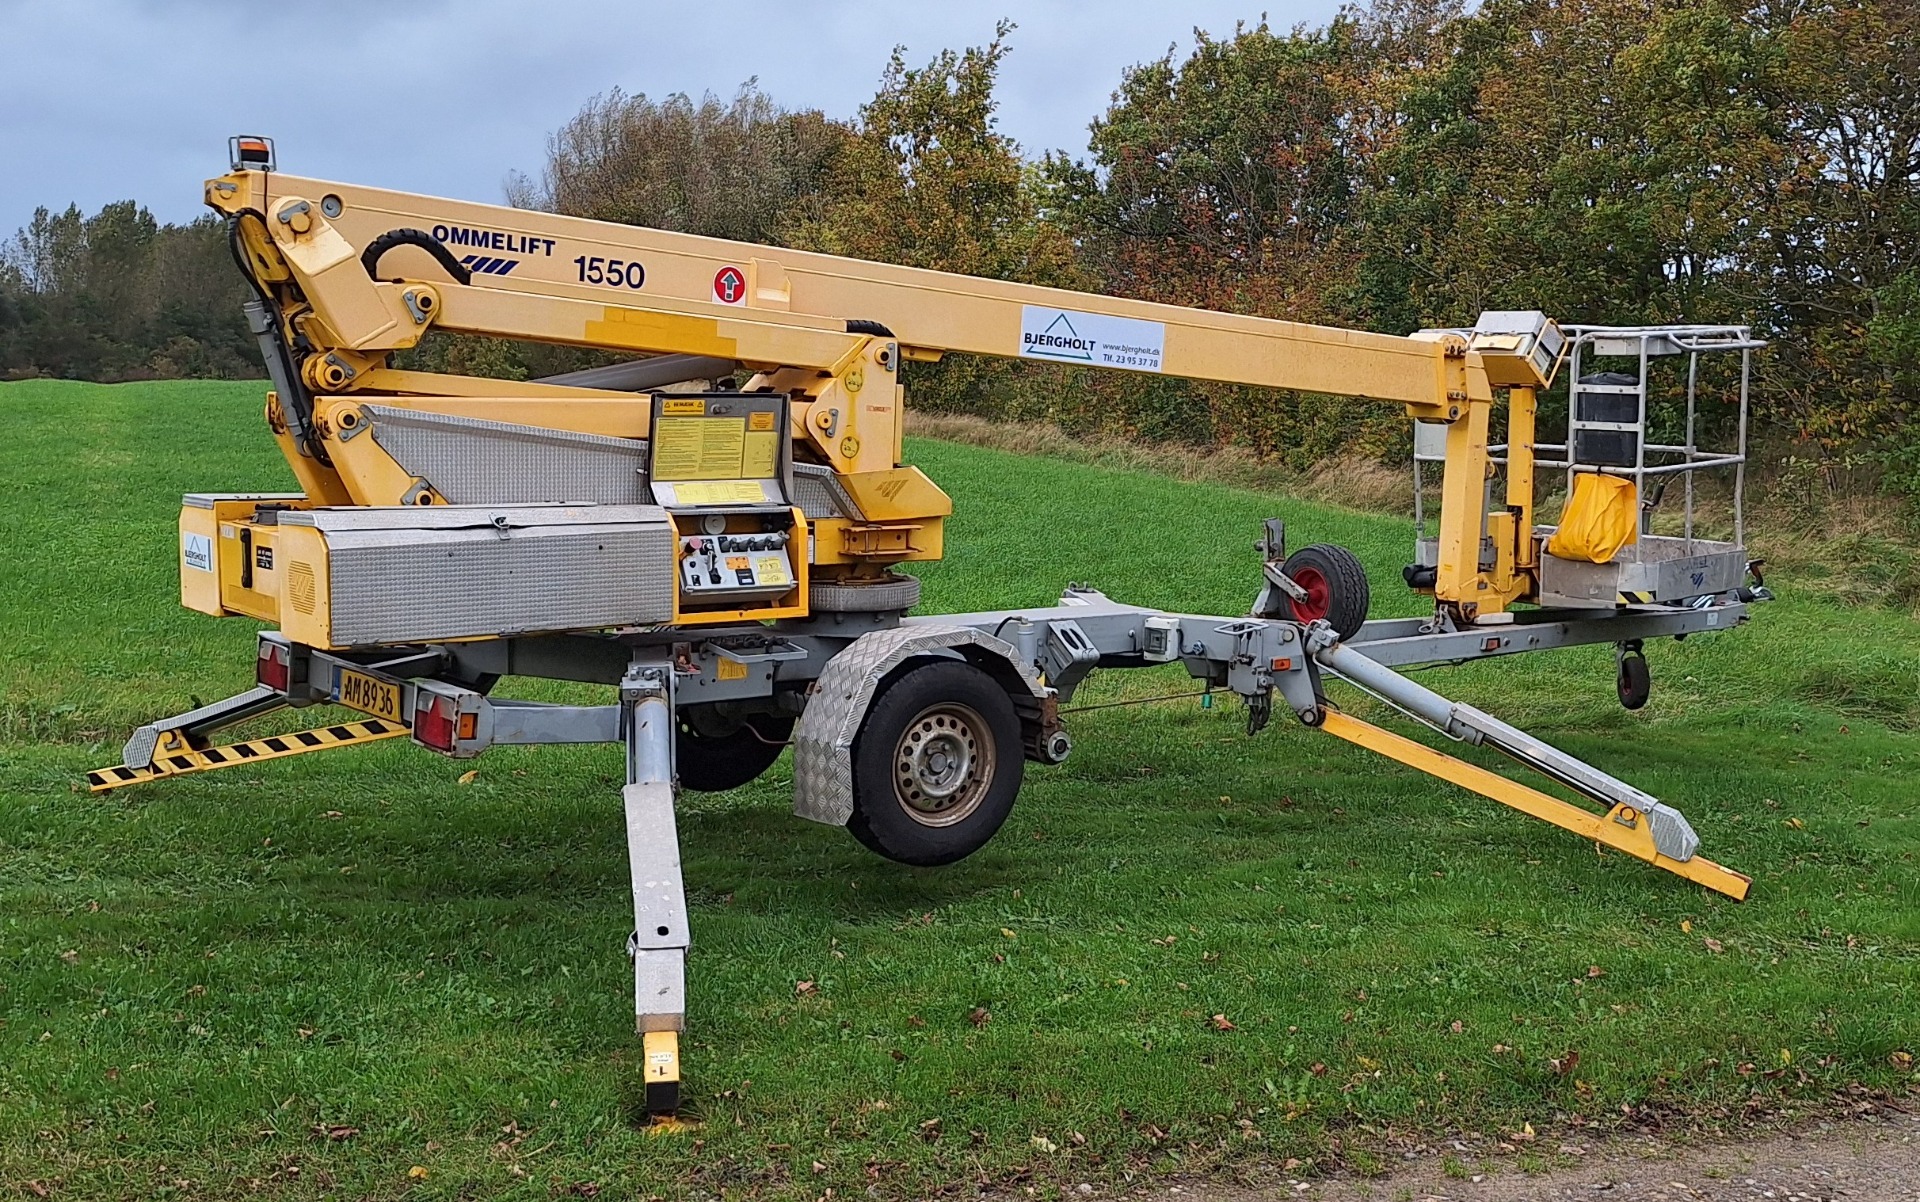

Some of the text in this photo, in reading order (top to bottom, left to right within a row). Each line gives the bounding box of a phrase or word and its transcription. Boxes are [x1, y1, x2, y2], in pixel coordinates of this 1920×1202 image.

[432, 225, 556, 256] OMMELIFT
[574, 256, 645, 289] 1550
[1024, 332, 1096, 351] BJERGHOLT
[1102, 343, 1160, 356] www.bjergholt.dk
[1115, 355, 1126, 364] 23
[1127, 356, 1137, 365] 95
[1138, 358, 1148, 366] 37
[1149, 359, 1159, 368] 78
